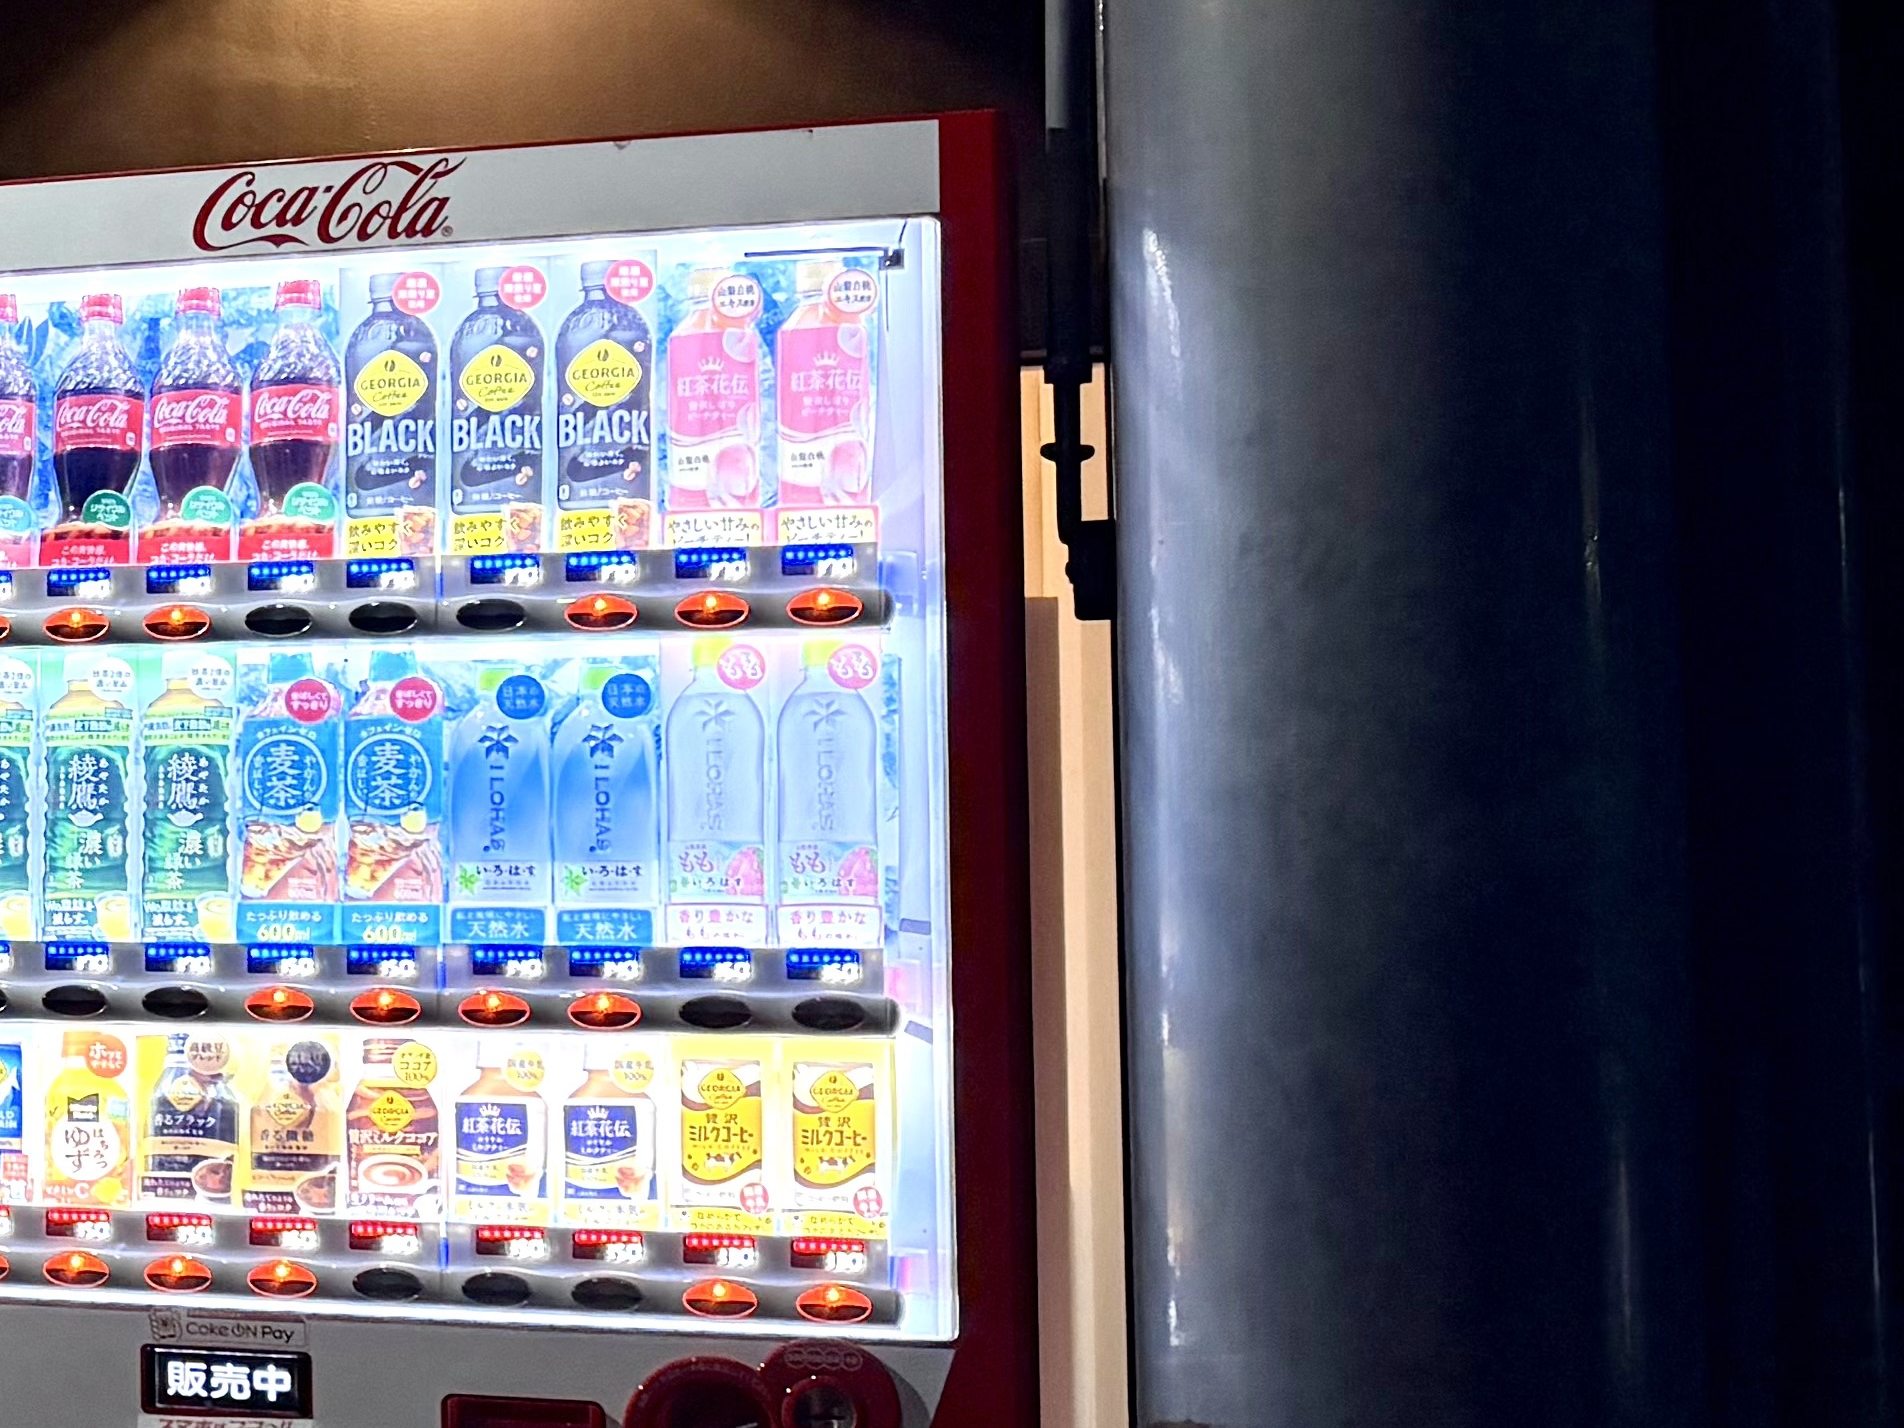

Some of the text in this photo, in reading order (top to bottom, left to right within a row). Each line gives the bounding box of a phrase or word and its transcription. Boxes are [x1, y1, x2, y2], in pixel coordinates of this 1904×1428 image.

[192, 157, 466, 253] Coca-Cola
[360, 376, 421, 391] GEORGIA
[466, 372, 527, 386] GEORGIA
[572, 366, 635, 381] GEORGIA
[790, 369, 863, 393] 紅茶花伝
[676, 375, 749, 397] 紅茶花伝
[56, 397, 129, 433] Coca-Cola
[154, 392, 227, 429] Coca-Cola
[254, 387, 329, 425] Coca-Cola
[347, 420, 435, 456] BLACK
[453, 415, 541, 452] BLACK
[558, 410, 650, 447] BLACK
[69, 753, 98, 810] 綾鷹
[168, 752, 198, 810] 綾鷹
[266, 742, 302, 808] 麦茶
[368, 742, 406, 807] 麦茶
[678, 851, 715, 874] もも
[789, 852, 826, 874] もも
[679, 909, 754, 924] 香り豊かな
[790, 909, 867, 924] 香り豊かな
[468, 921, 530, 939] 天然水
[575, 922, 638, 941] 天然水
[462, 1117, 523, 1136] 紅茶花伝
[570, 1120, 633, 1138] 紅茶花伝
[689, 1125, 754, 1143] ミルクコーヒー
[800, 1128, 868, 1147] ミルクコーヒー
[64, 1127, 90, 1173] ゆず
[186, 1322, 229, 1336] Coke
[262, 1326, 295, 1343] Pay
[167, 1361, 292, 1402] 販売中
